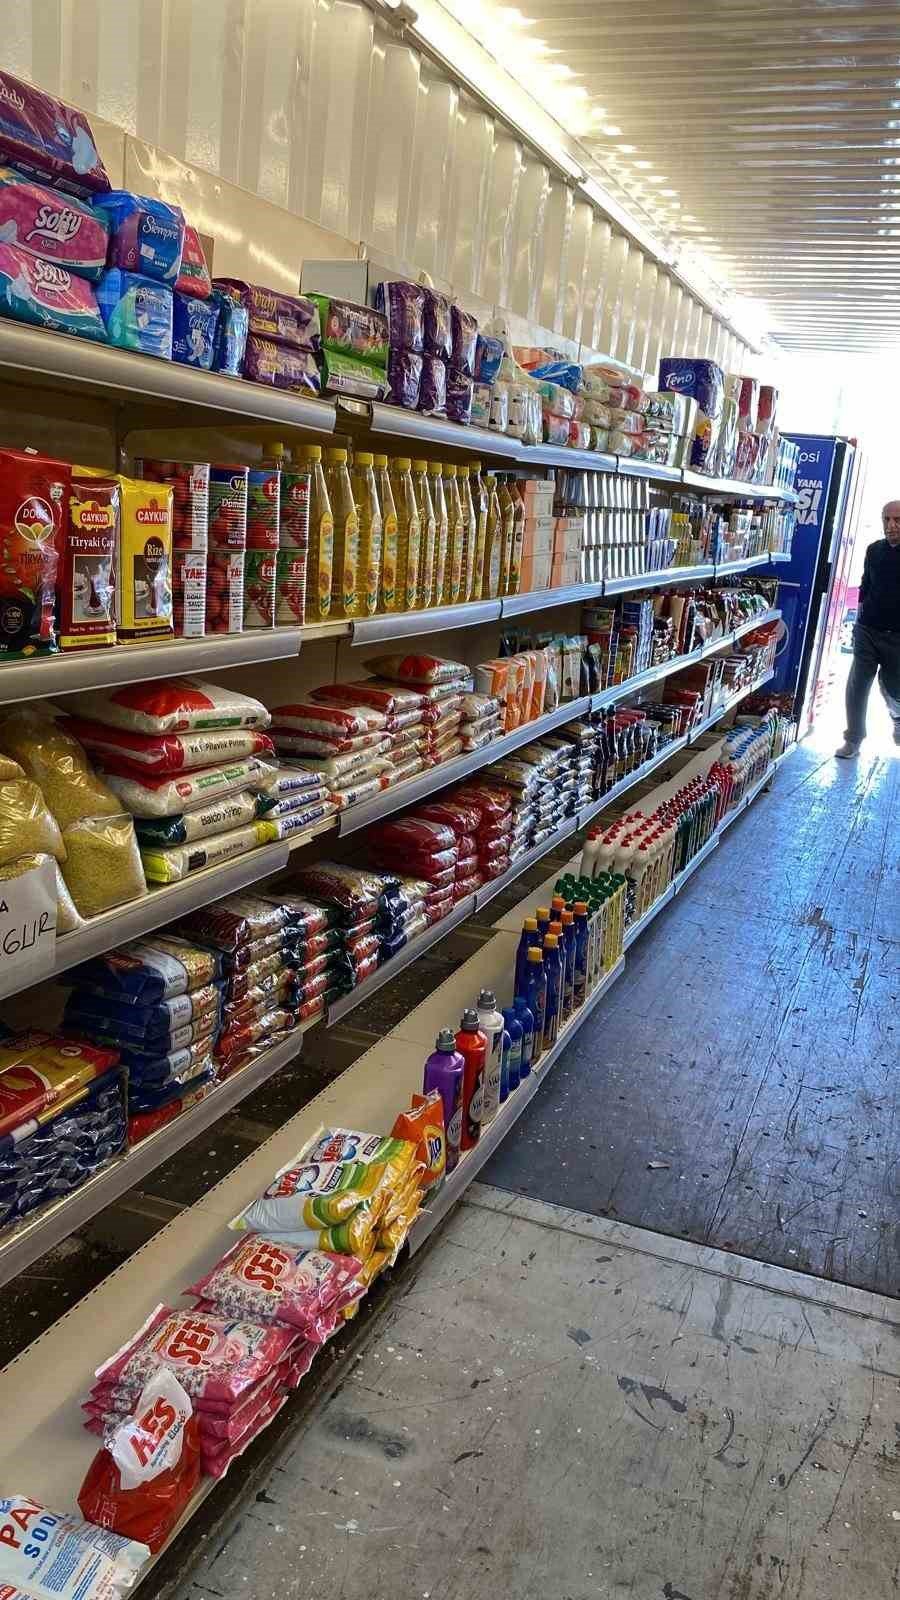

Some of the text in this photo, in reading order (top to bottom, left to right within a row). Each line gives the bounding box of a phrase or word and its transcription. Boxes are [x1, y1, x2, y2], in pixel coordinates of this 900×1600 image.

[142, 215, 179, 241] Siempre
[69, 536, 100, 549] Tiryaki
[0, 1500, 43, 1550] PA
[23, 1513, 66, 1559] SOD
